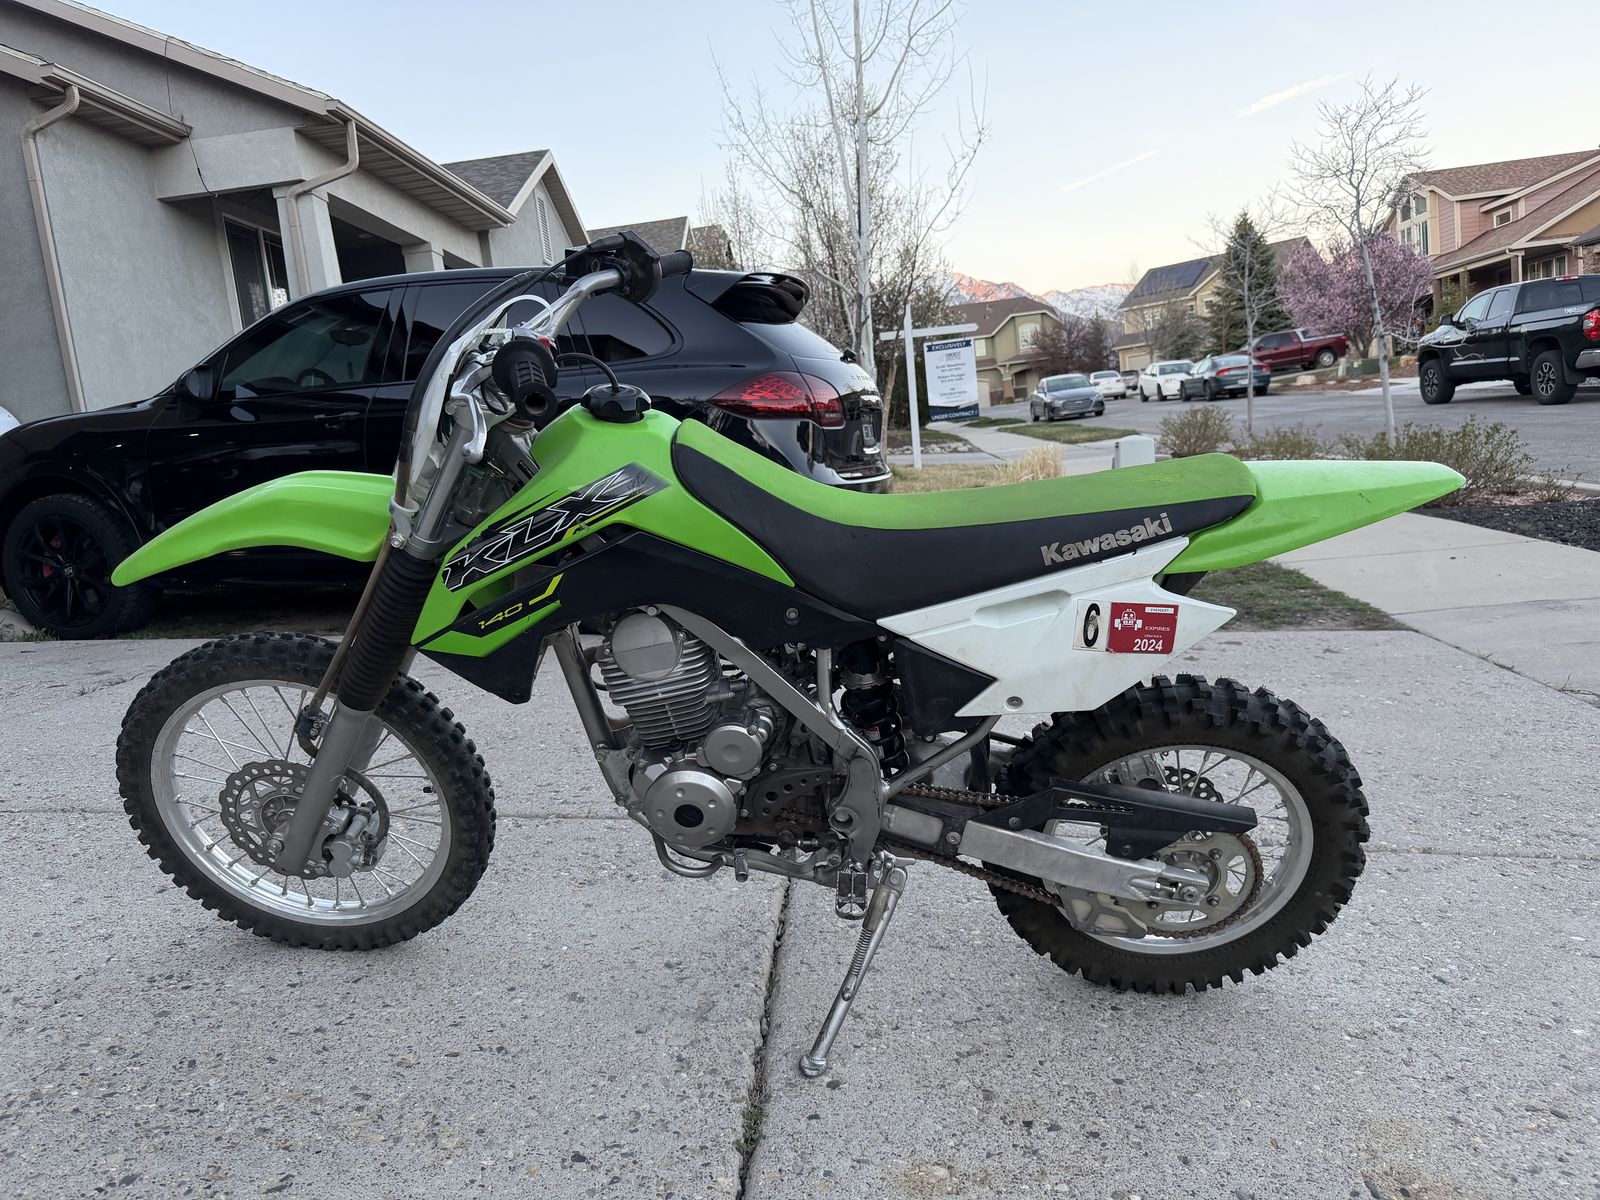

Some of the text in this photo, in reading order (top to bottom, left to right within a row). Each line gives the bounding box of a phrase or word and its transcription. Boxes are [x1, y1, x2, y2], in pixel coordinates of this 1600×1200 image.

[932, 342, 966, 351] EXCLUSIVELY
[931, 410, 975, 421] UNDER CONTRACT
[444, 469, 629, 591] KLX
[1040, 512, 1173, 566] Kawasaki
[478, 603, 523, 630] 140
[1133, 638, 1163, 652] 2024
